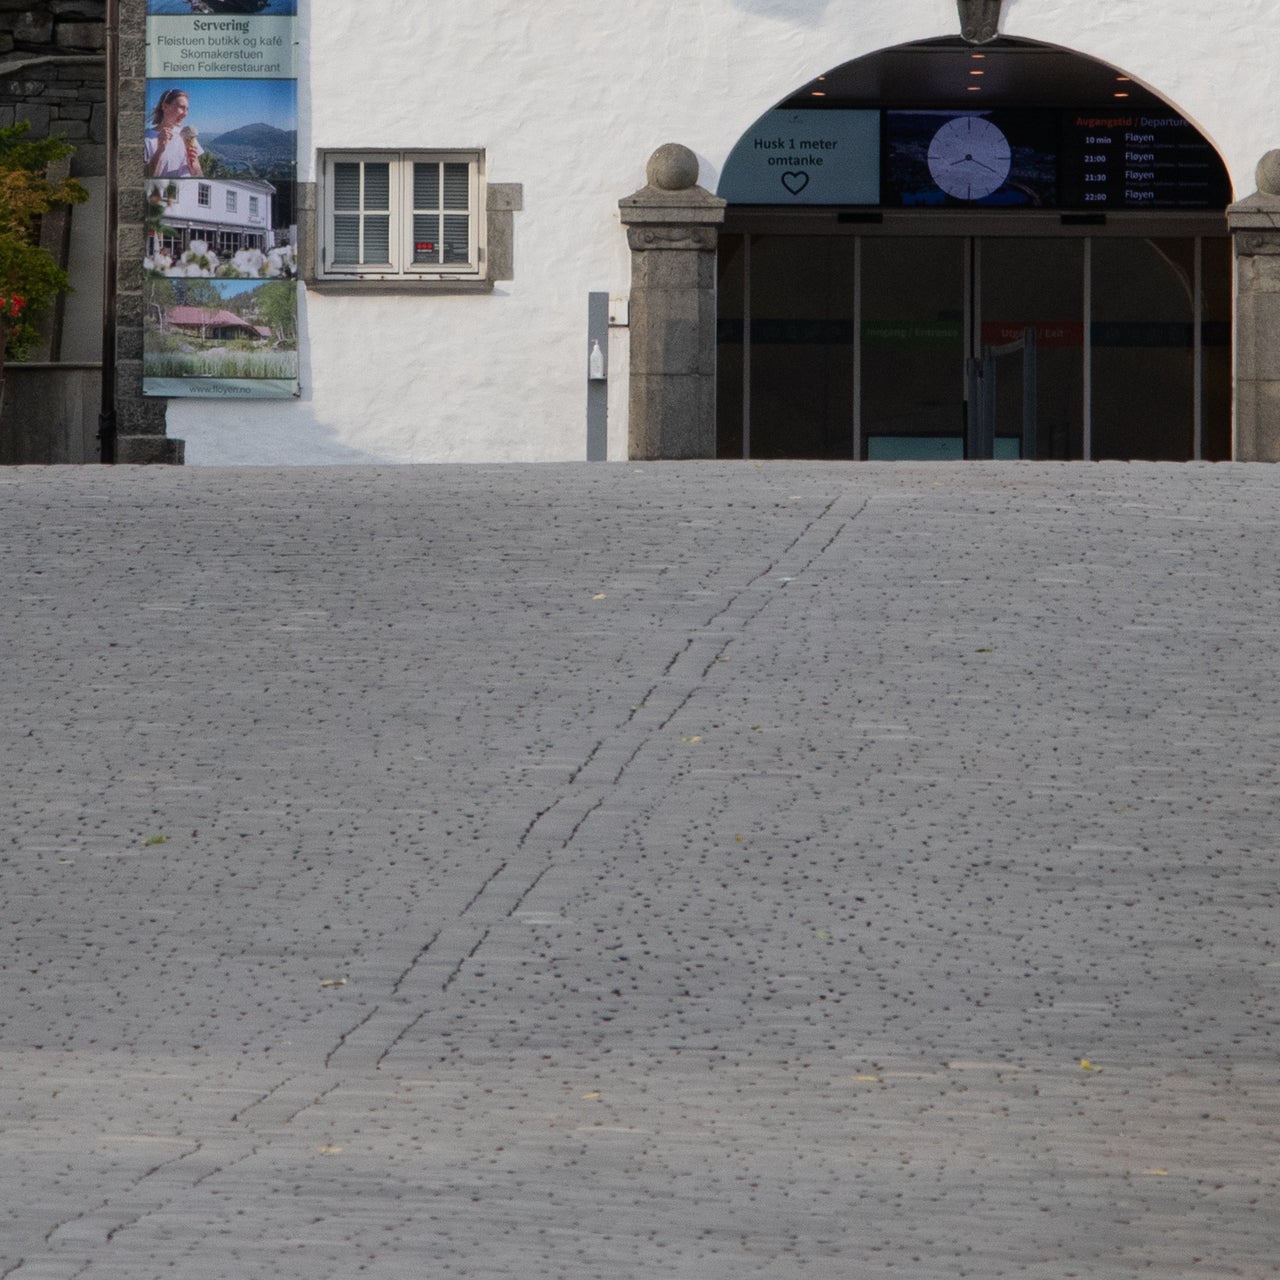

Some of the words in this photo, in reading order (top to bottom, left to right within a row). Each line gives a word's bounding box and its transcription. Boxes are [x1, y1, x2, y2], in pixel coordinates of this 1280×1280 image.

[193, 19, 250, 34] Servering
[157, 35, 205, 46] Fløistuen
[208, 35, 240, 46] butikk
[243, 38, 257, 48] og
[260, 35, 283, 46] kafé
[180, 49, 263, 60] Skomakerstuen
[198, 61, 280, 72] Folkerestaurant
[1076, 117, 1133, 128] Avgangstid
[1125, 133, 1154, 142] Fløyen
[754, 138, 785, 149] Husk
[789, 138, 795, 149] 1
[800, 139, 838, 150] meter
[768, 155, 824, 166] omtanke
[1085, 155, 1106, 163] 21:00
[1125, 152, 1154, 162] Fløyen
[1125, 170, 1154, 180] Fløyen
[1125, 189, 1154, 200] Fløyen
